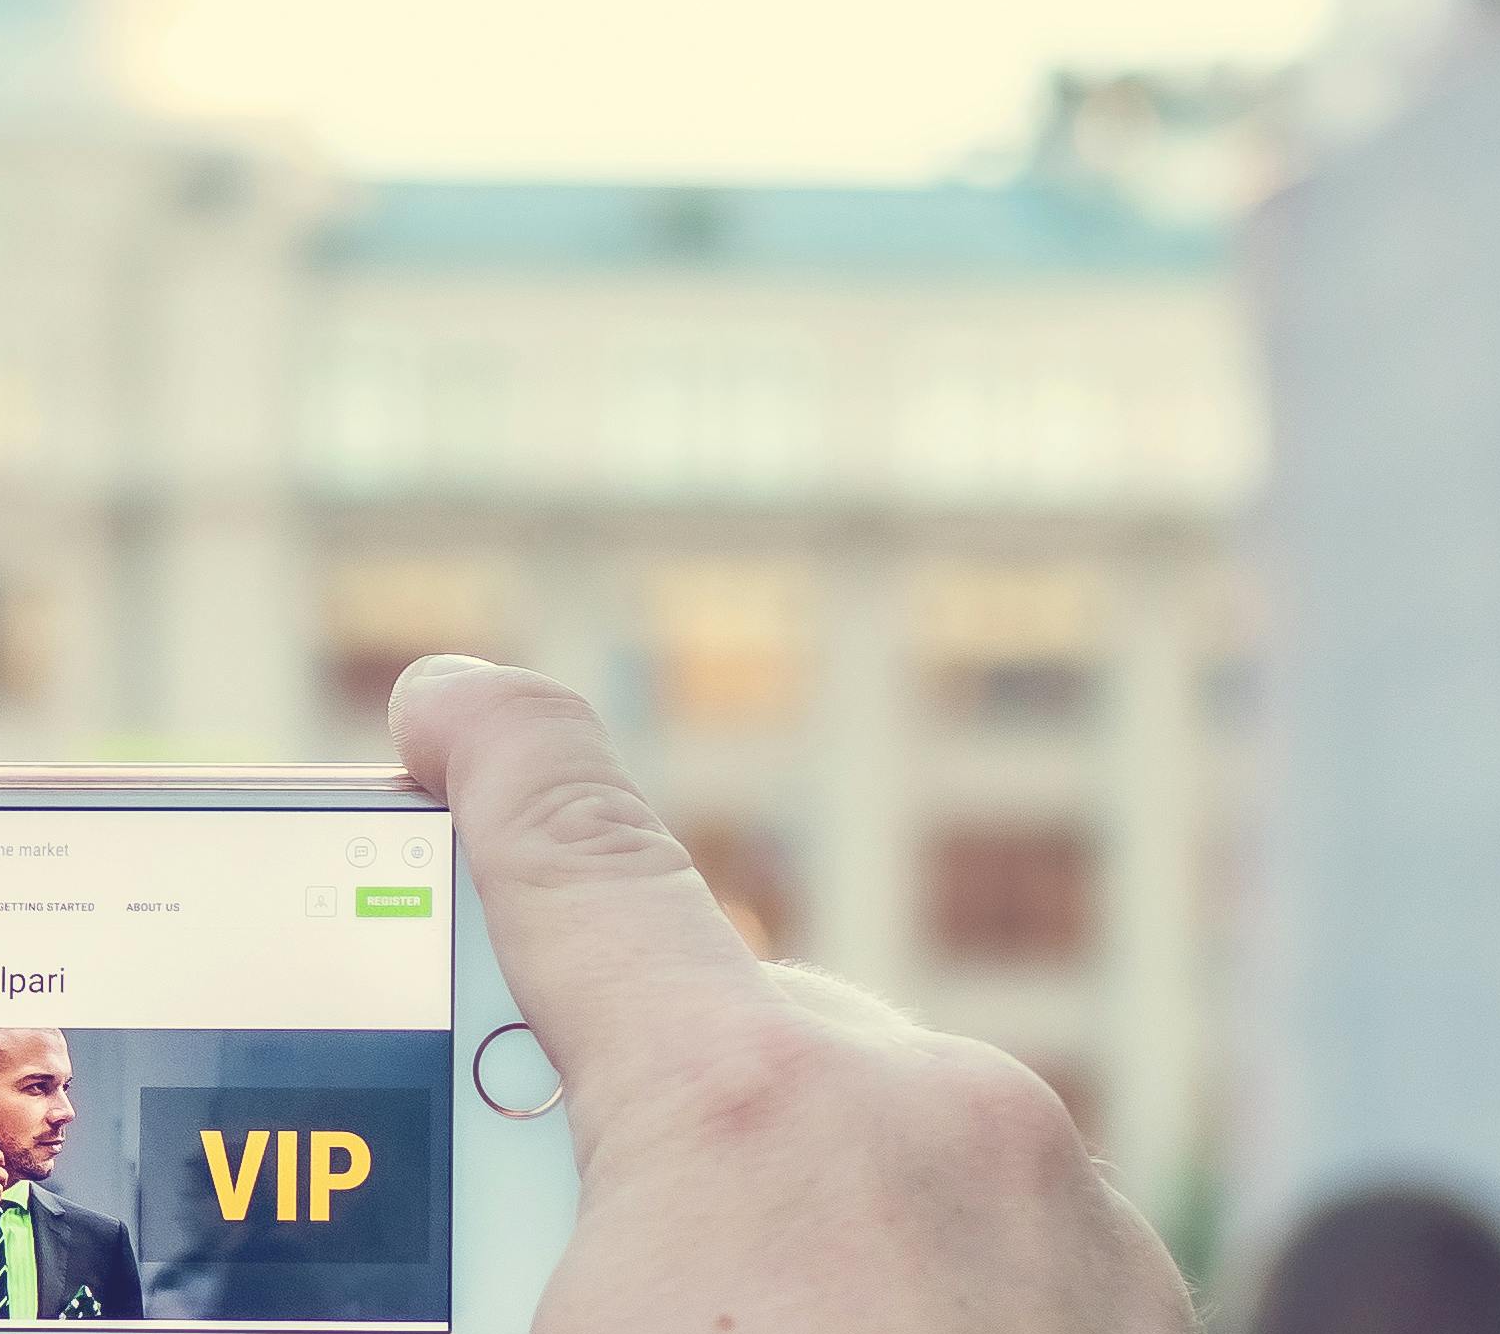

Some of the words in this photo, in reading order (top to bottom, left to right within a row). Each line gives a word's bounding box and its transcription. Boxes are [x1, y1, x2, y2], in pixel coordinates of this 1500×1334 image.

[19, 842, 70, 857] market
[367, 896, 421, 906] REGISTER
[46, 902, 95, 912] STARTED
[126, 903, 161, 912] ABOUT
[166, 903, 180, 912] US
[200, 1130, 372, 1222] VIP
